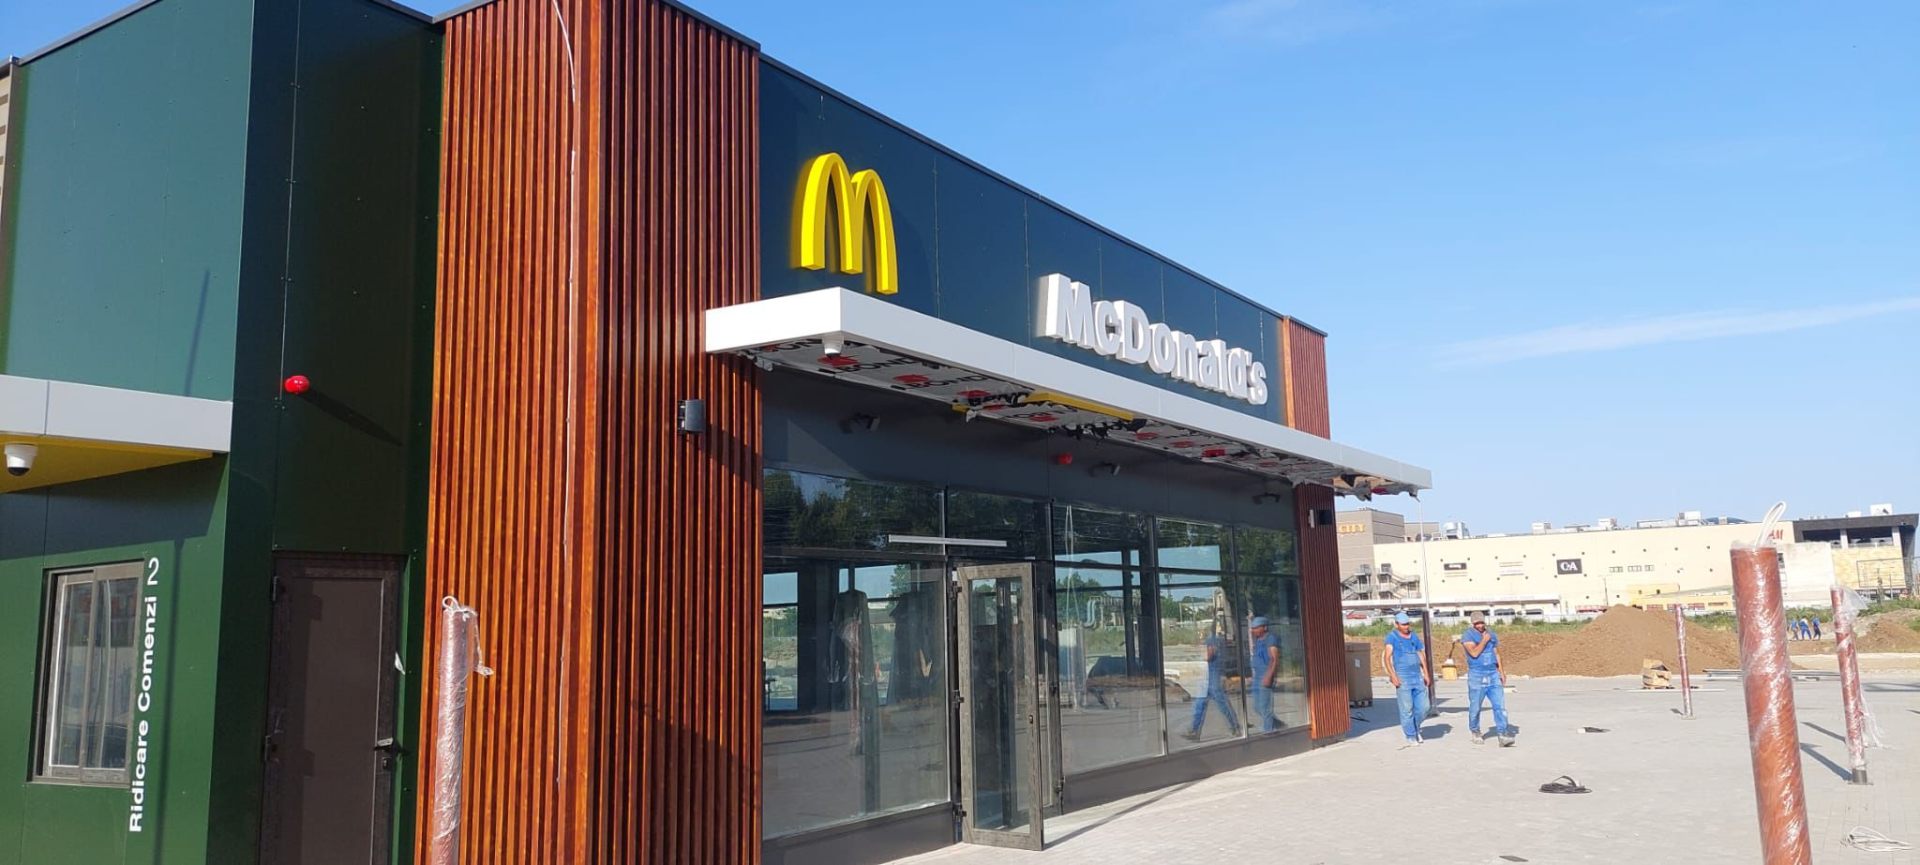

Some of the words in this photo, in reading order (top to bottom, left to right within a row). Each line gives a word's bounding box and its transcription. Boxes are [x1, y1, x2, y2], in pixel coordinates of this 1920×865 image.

[1045, 273, 1268, 405] McDonald's
[147, 557, 159, 586] 2
[137, 596, 157, 712] Comenzi
[129, 719, 149, 832] Ridicare
